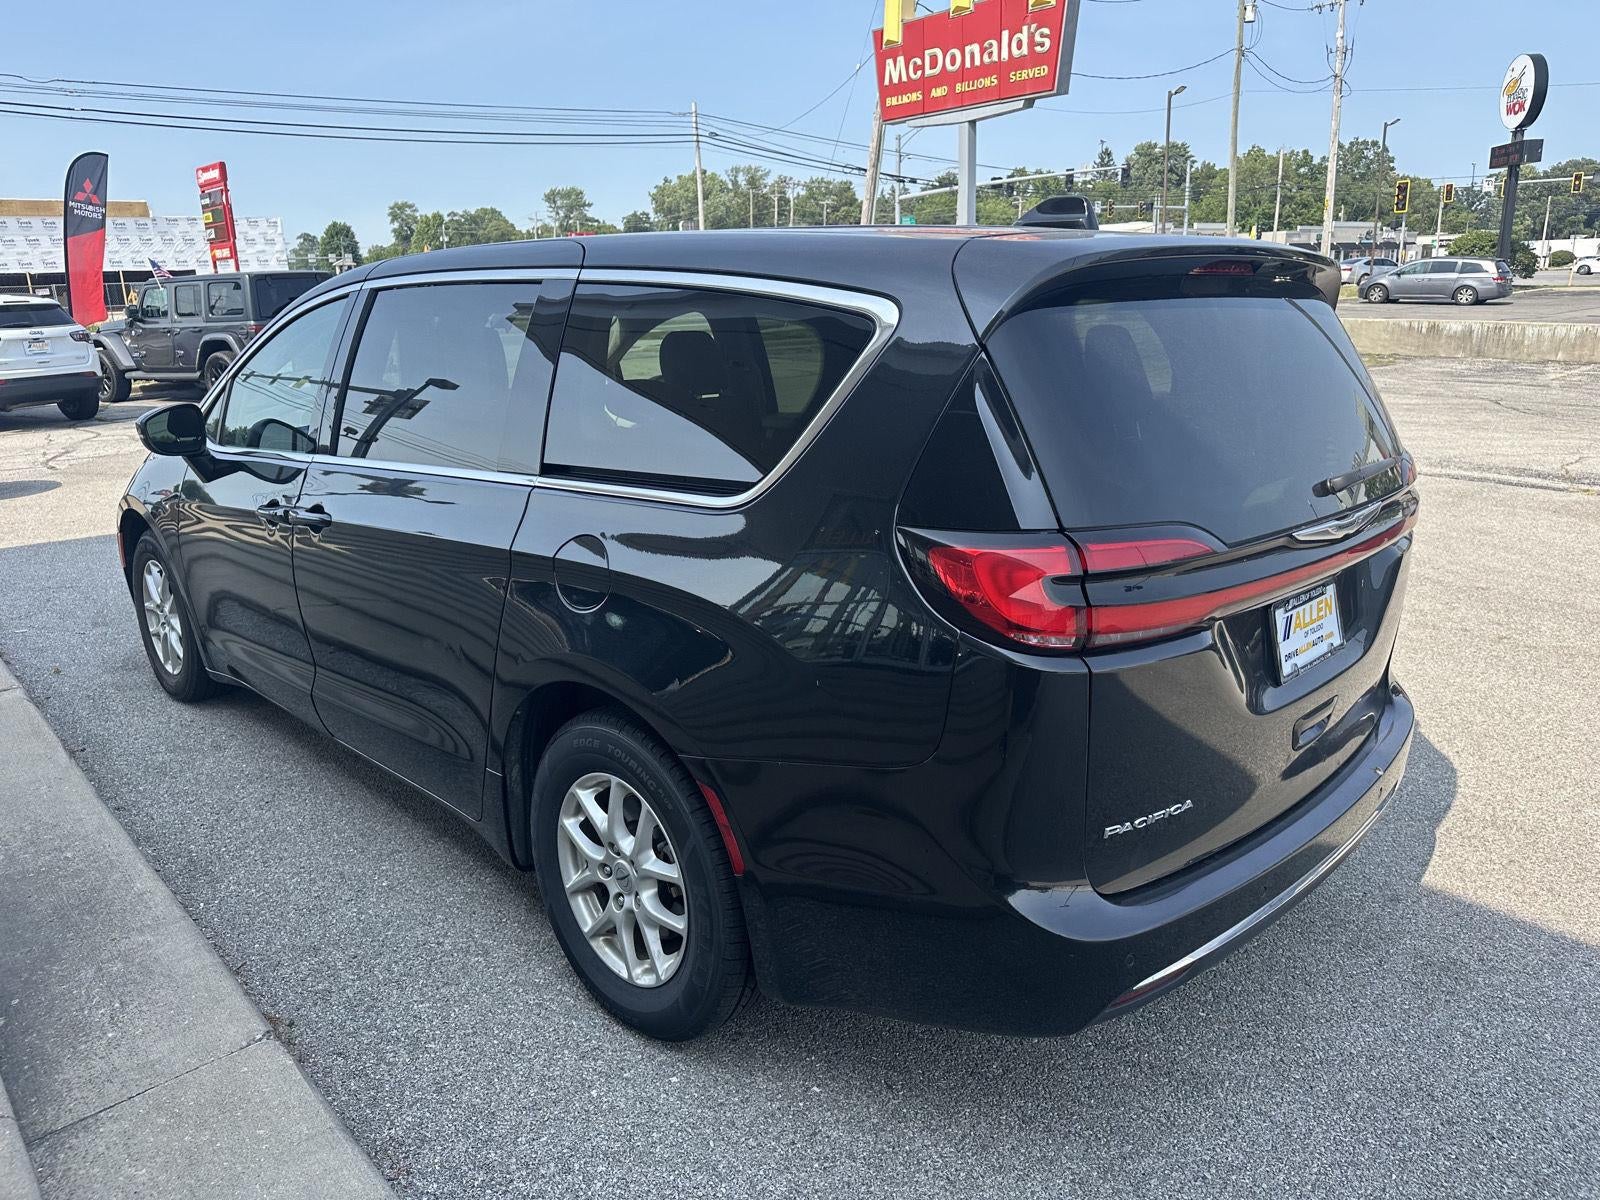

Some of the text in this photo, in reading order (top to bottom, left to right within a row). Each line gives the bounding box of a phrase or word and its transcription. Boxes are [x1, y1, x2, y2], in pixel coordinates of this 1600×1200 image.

[884, 23, 1051, 88] McDonald's
[886, 65, 1049, 107] BILLIONS AND BILLIONS SERVED
[1506, 100, 1526, 116] WOK
[69, 201, 105, 214] MITSUBISH
[74, 208, 102, 219] MOTORS
[1293, 594, 1333, 635] ALLEN
[1309, 622, 1324, 636] TOLEDO
[572, 737, 657, 791] EDGE TOURING
[1103, 799, 1193, 839] PACIFICA
